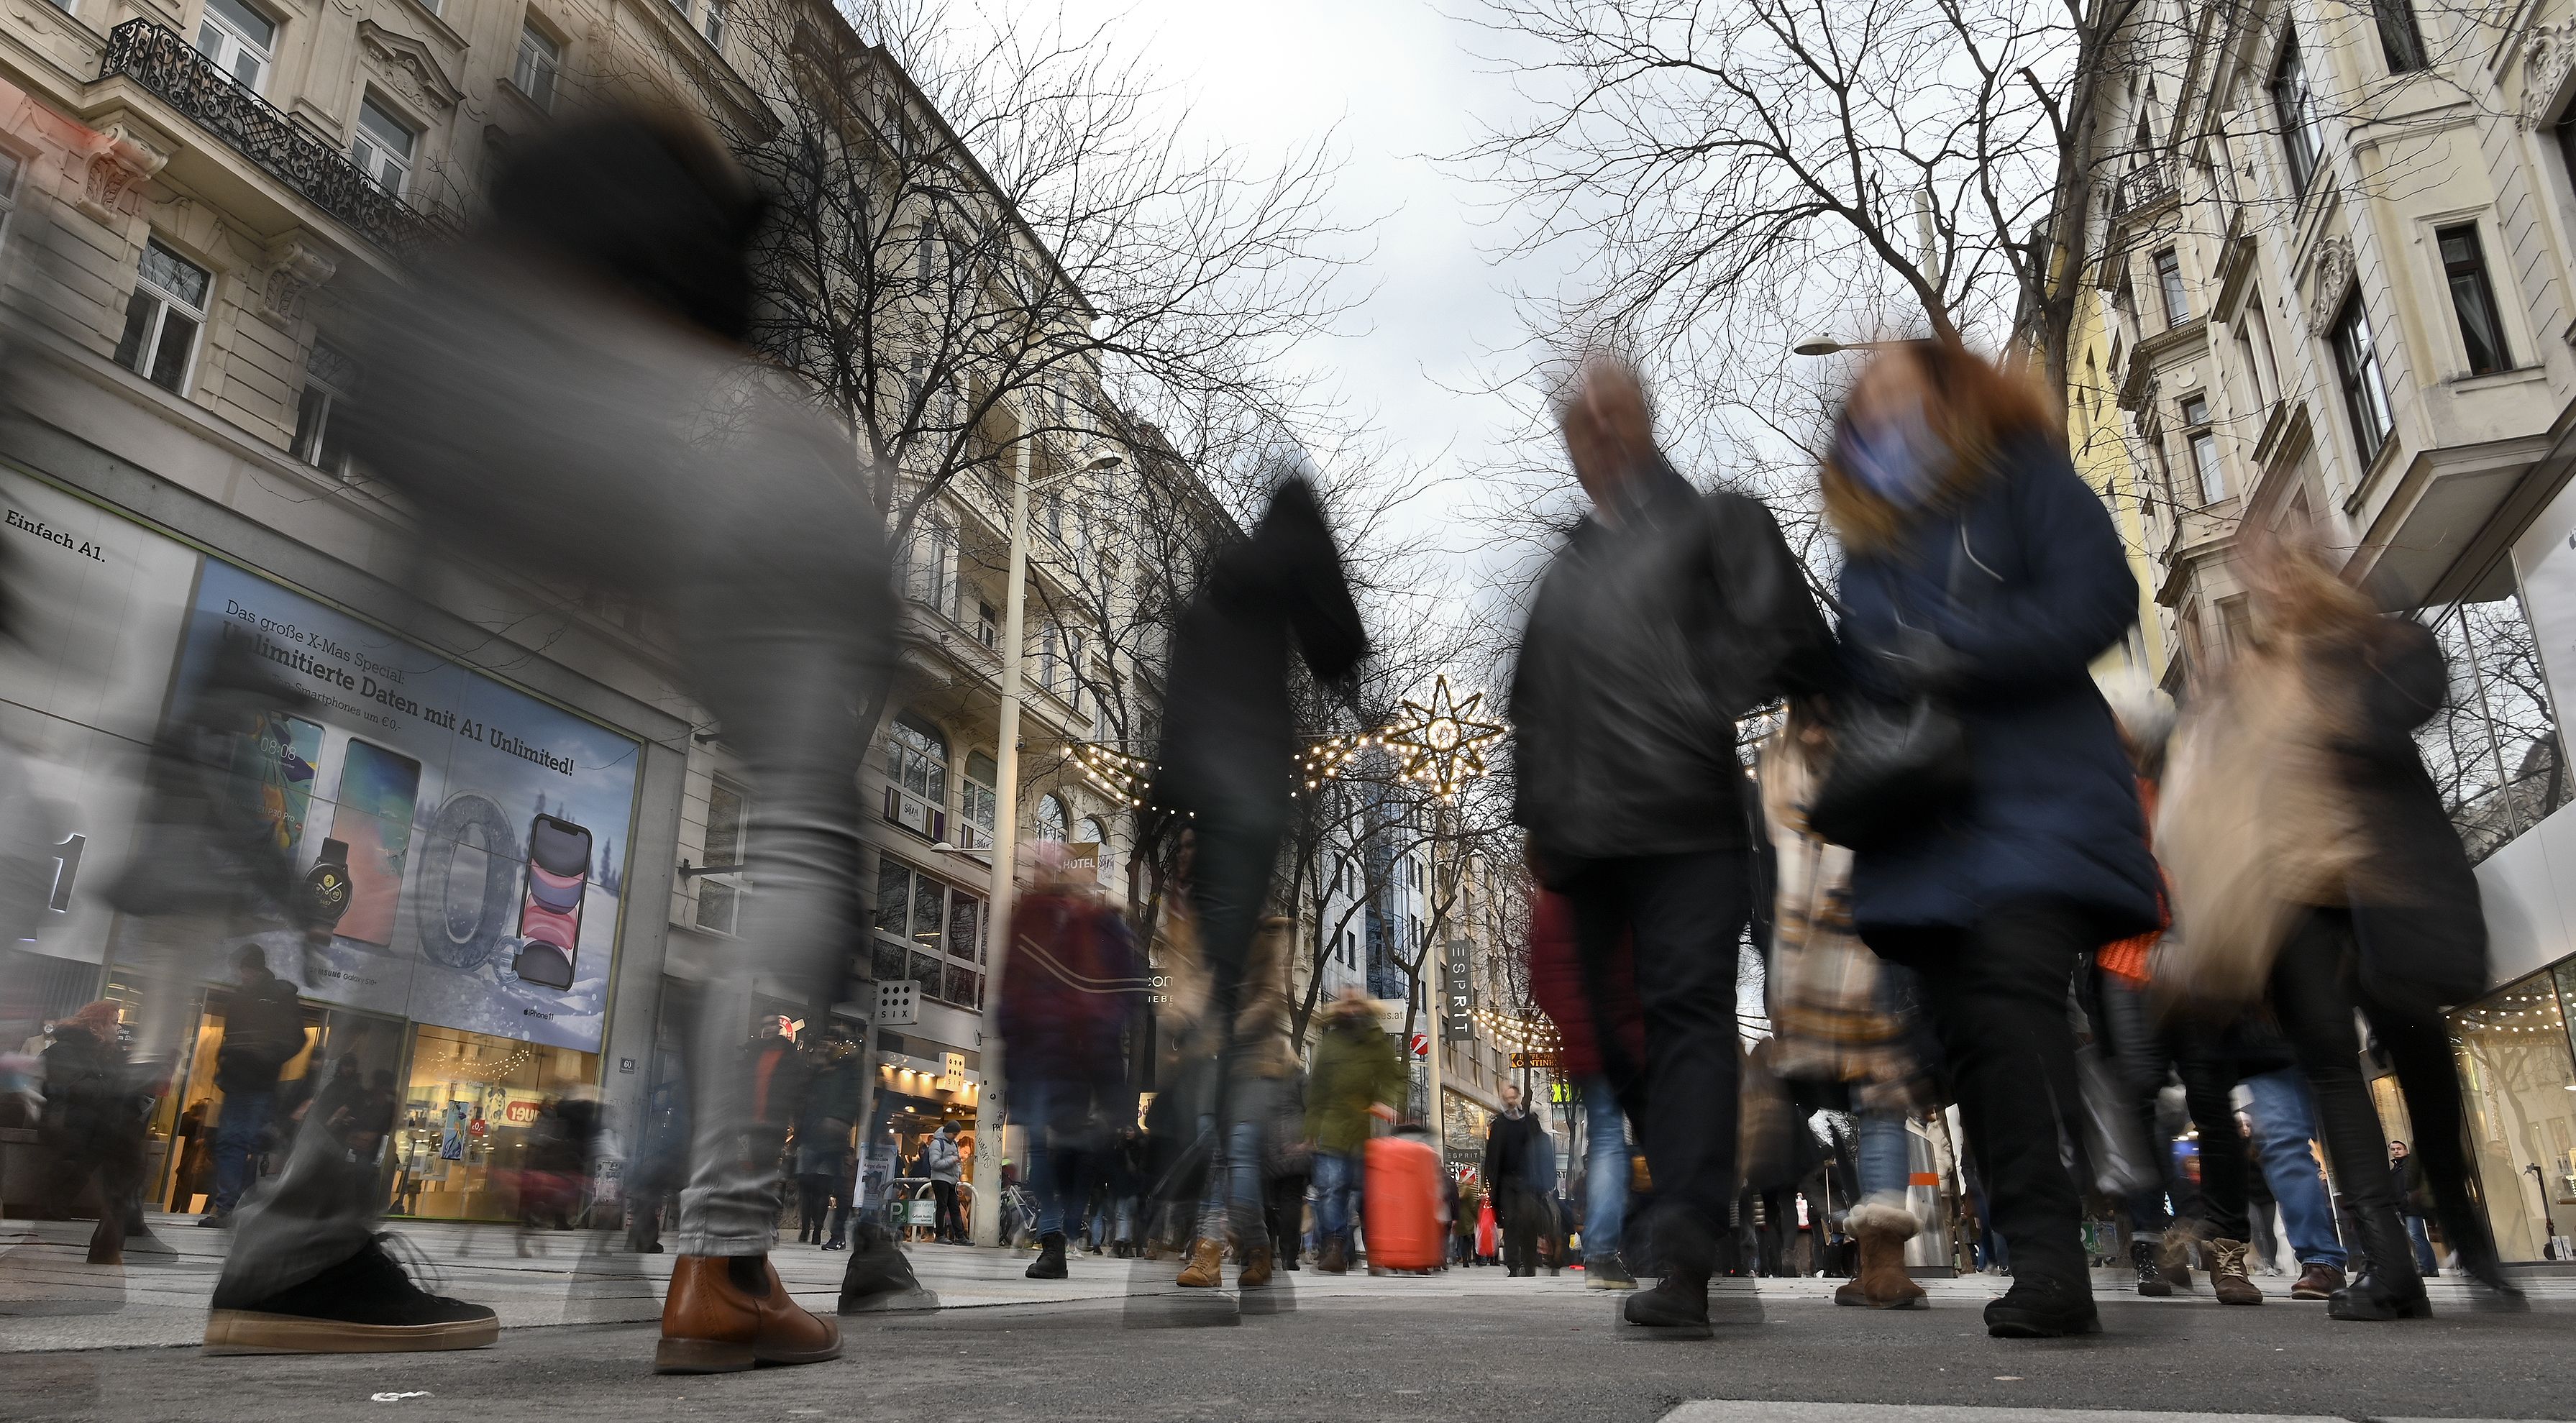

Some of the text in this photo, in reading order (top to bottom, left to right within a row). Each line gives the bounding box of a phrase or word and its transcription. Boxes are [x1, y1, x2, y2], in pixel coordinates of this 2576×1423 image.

[5, 509, 106, 563] Einfach A1.
[226, 599, 405, 684] Das große X-Mas Special:
[223, 621, 575, 776] Ulimitierte Daten mit A1 Unlimited!
[364, 712, 379, 723] um
[261, 738, 296, 760] 08:08
[268, 807, 282, 818] P30
[283, 811, 296, 822] Pro
[1063, 858, 1096, 869] HOTEL
[309, 966, 342, 979] SAMSUNG
[1452, 947, 1469, 1033] ESPRIT
[529, 1010, 548, 1020] iPhone
[881, 1010, 908, 1018] SIX
[1377, 1010, 1404, 1020] es.at
[624, 1060, 631, 1069] 60
[891, 1202, 903, 1222] P
